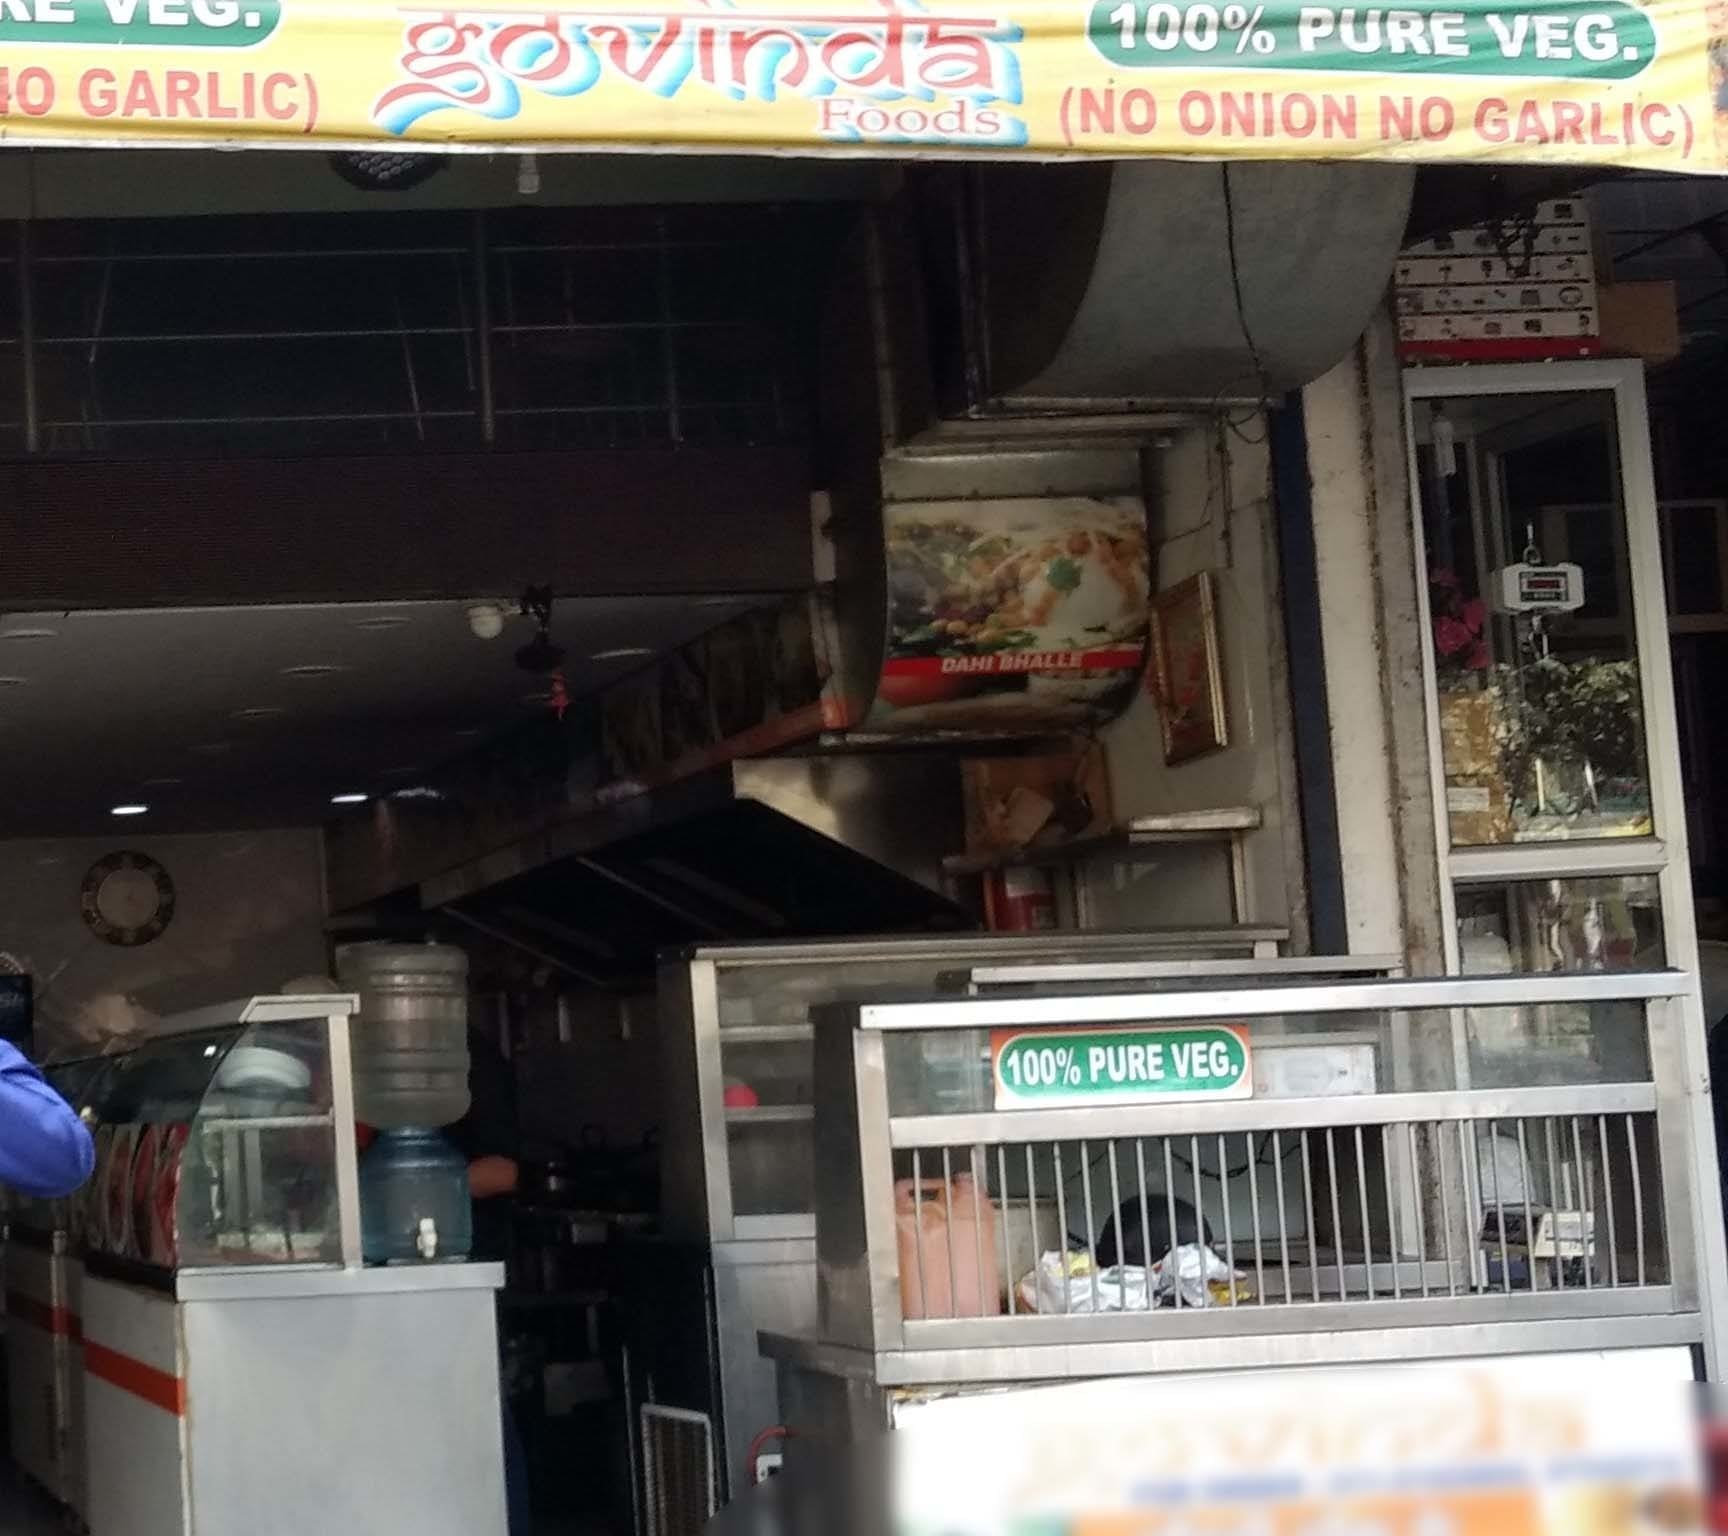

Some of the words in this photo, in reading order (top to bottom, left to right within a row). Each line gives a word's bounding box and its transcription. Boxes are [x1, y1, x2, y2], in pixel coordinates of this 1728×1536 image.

[1109, 1, 1275, 54] 100%
[1296, 8, 1470, 58] PURE
[1485, 13, 1640, 62] VEG.
[76, 68, 320, 132] GARLIC)
[817, 96, 1010, 140] Foods
[1059, 86, 1157, 145] (NO
[1178, 90, 1358, 141] ONION
[1378, 94, 1456, 142] NO
[1473, 100, 1695, 159] GARLIC)
[941, 655, 994, 674] DAHI
[998, 651, 1084, 672] BHALLE
[1006, 1046, 1081, 1086] 100%
[1089, 1042, 1165, 1082] PURE
[1170, 1040, 1240, 1079] VEG.
